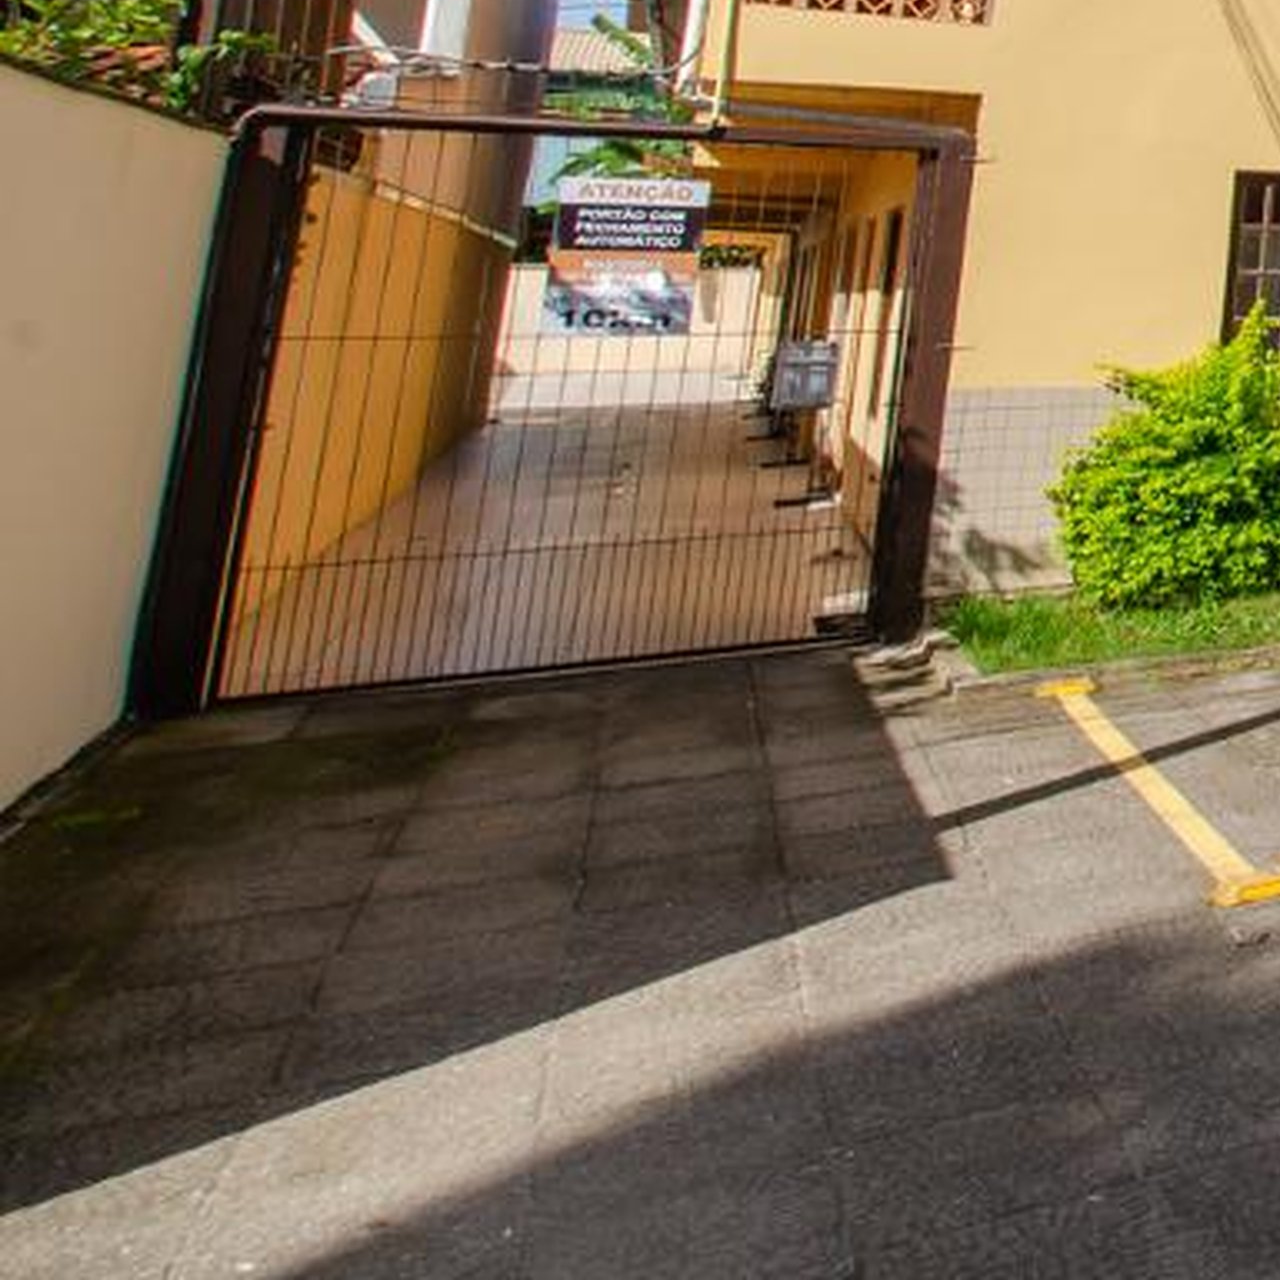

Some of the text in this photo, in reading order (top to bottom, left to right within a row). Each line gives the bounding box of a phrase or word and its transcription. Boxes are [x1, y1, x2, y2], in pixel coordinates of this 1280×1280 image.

[579, 181, 694, 202] ATENÇÃO
[578, 207, 647, 221] PORTÃO
[574, 234, 682, 248] AUTOMÁTICO
